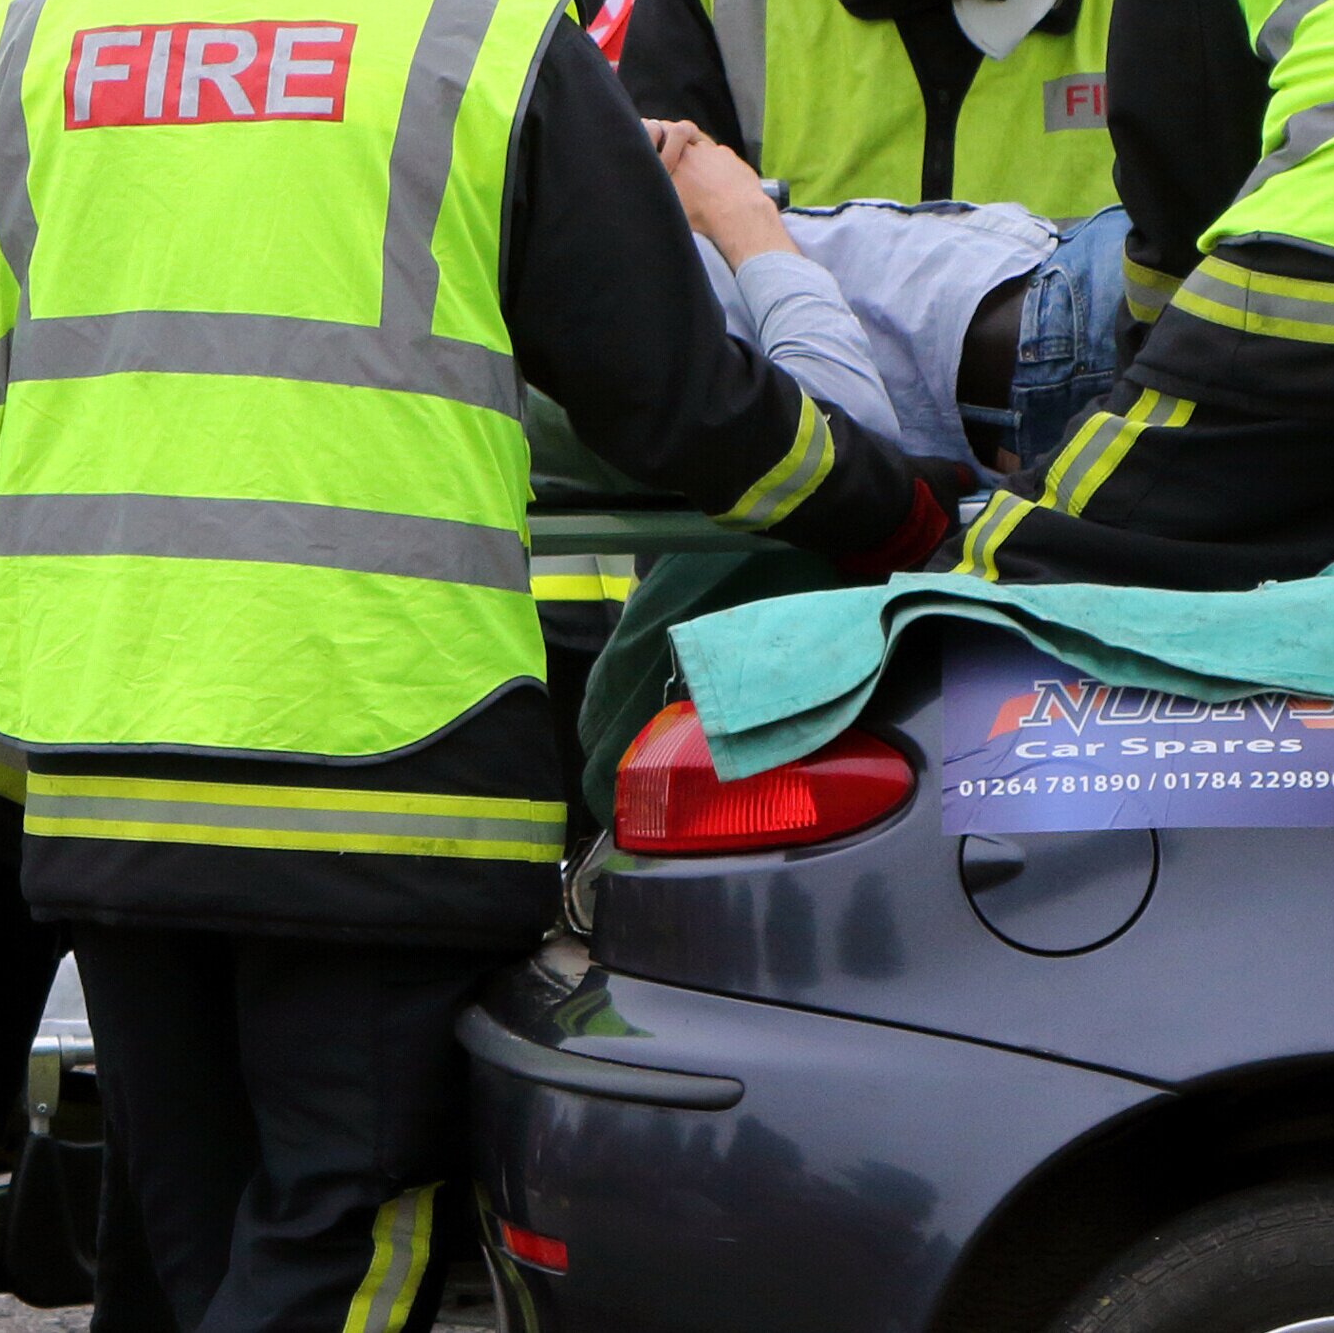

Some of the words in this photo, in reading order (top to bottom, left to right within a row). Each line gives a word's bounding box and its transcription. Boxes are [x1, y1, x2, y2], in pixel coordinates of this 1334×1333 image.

[73, 27, 345, 123] FIRE
[1066, 84, 1108, 117] FI
[1015, 740, 1105, 759] Car
[1120, 737, 1303, 759] Spares
[959, 777, 1037, 797] 01264
[1045, 773, 1141, 793] 781890
[1164, 772, 1243, 790] 01784
